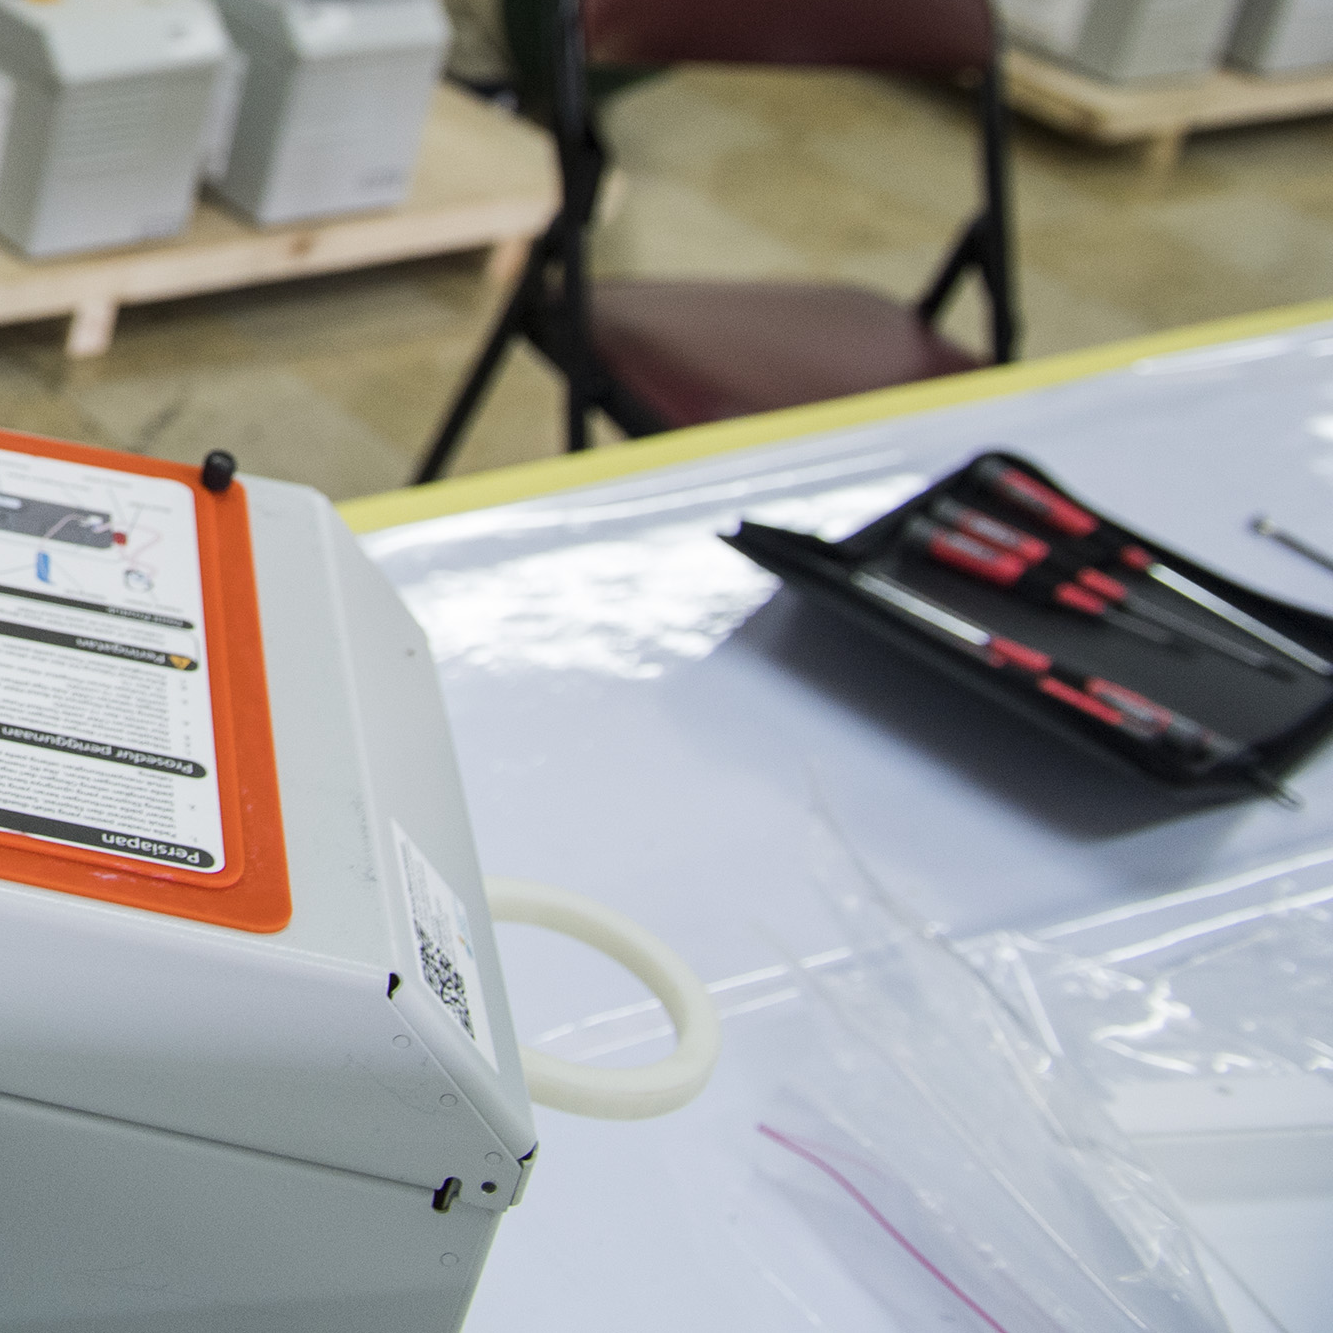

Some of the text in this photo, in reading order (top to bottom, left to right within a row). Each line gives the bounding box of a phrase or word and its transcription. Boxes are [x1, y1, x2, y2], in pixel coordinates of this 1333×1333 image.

[1, 725, 113, 757] penggunaan
[116, 749, 194, 774] Prosedur
[101, 832, 200, 864] Persiapan
